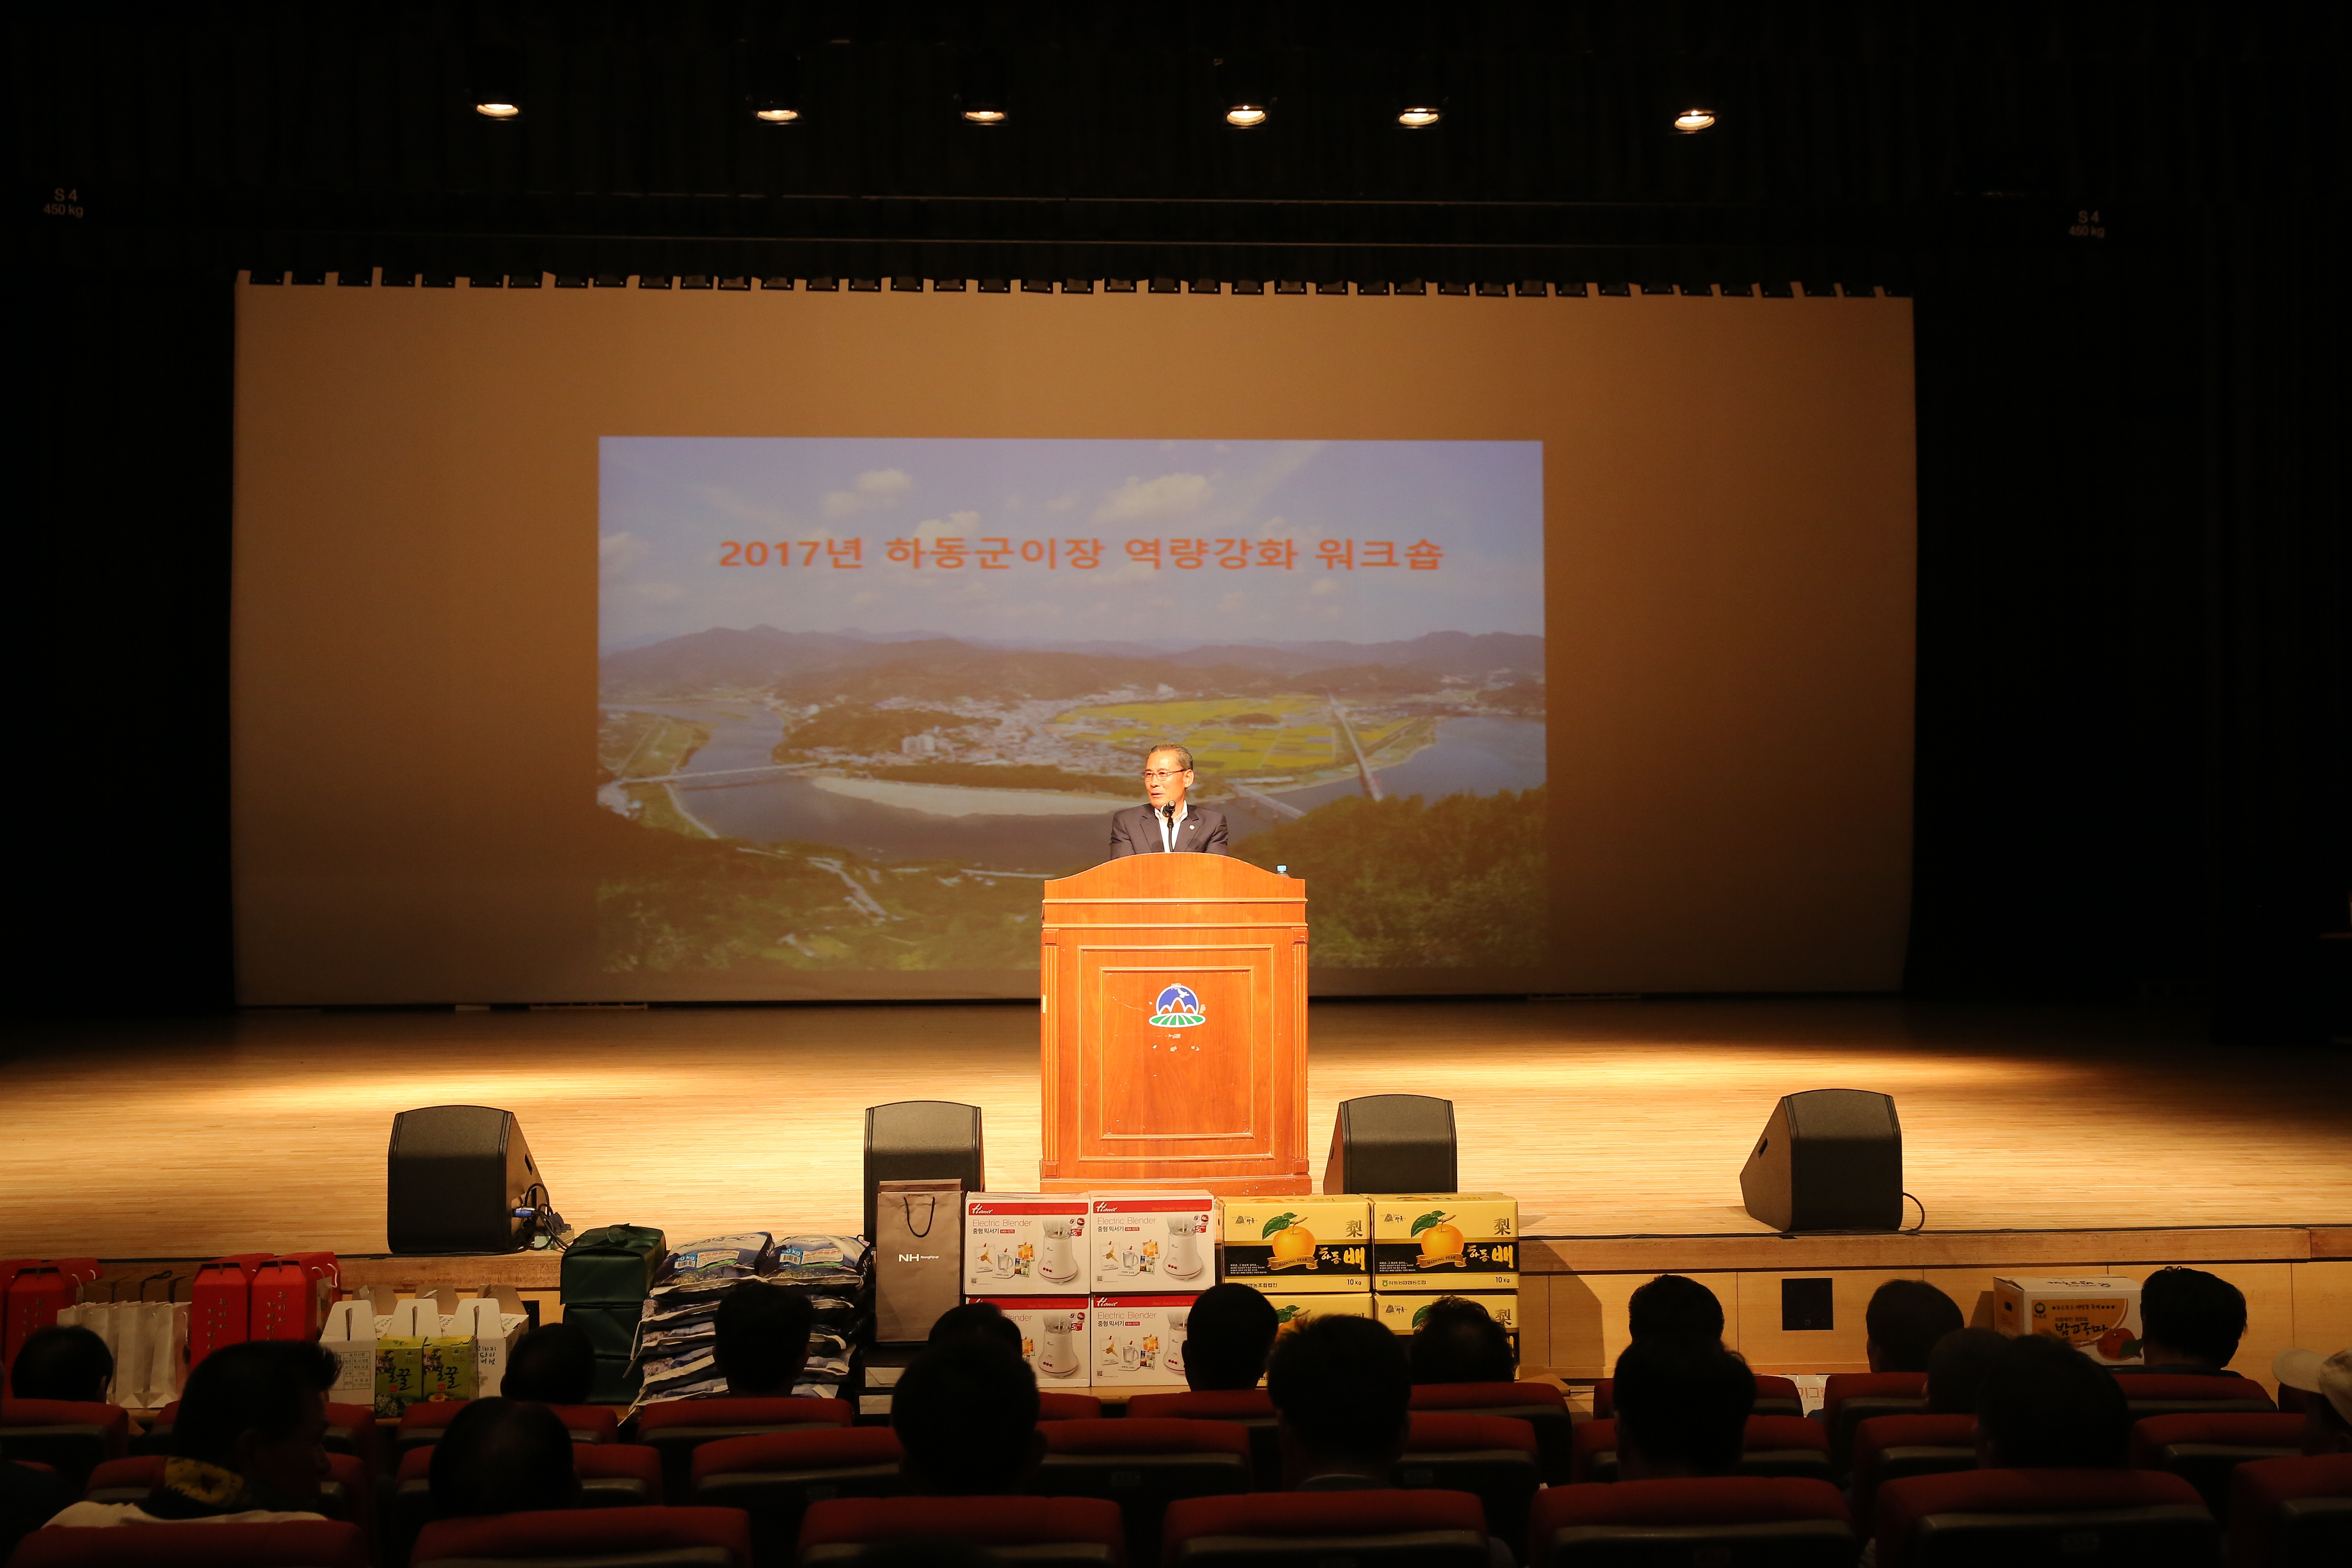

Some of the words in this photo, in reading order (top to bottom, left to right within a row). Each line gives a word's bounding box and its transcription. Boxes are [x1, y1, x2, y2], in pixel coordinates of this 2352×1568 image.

[55, 188, 65, 201] S
[68, 188, 77, 202] 4
[719, 538, 862, 569] 2017년
[886, 537, 1105, 570] 하동군이장
[1125, 538, 1298, 570] 역량강화
[1316, 538, 1443, 570] 워크숍
[971, 1203, 993, 1214] Hanil
[1096, 1202, 1118, 1212] Hanil
[1346, 1220, 1363, 1237] 梨
[1494, 1218, 1511, 1236] 梨
[899, 1254, 919, 1262] NH
[1343, 1247, 1365, 1271] 배
[1492, 1245, 1513, 1269] 배
[1096, 1297, 1118, 1307] Hanil
[1495, 1309, 1512, 1325] 梨
[2055, 1322, 2109, 1336] 밤고구마
[384, 1368, 413, 1390] 벌꿀
[433, 1364, 461, 1389] 벌꿀
